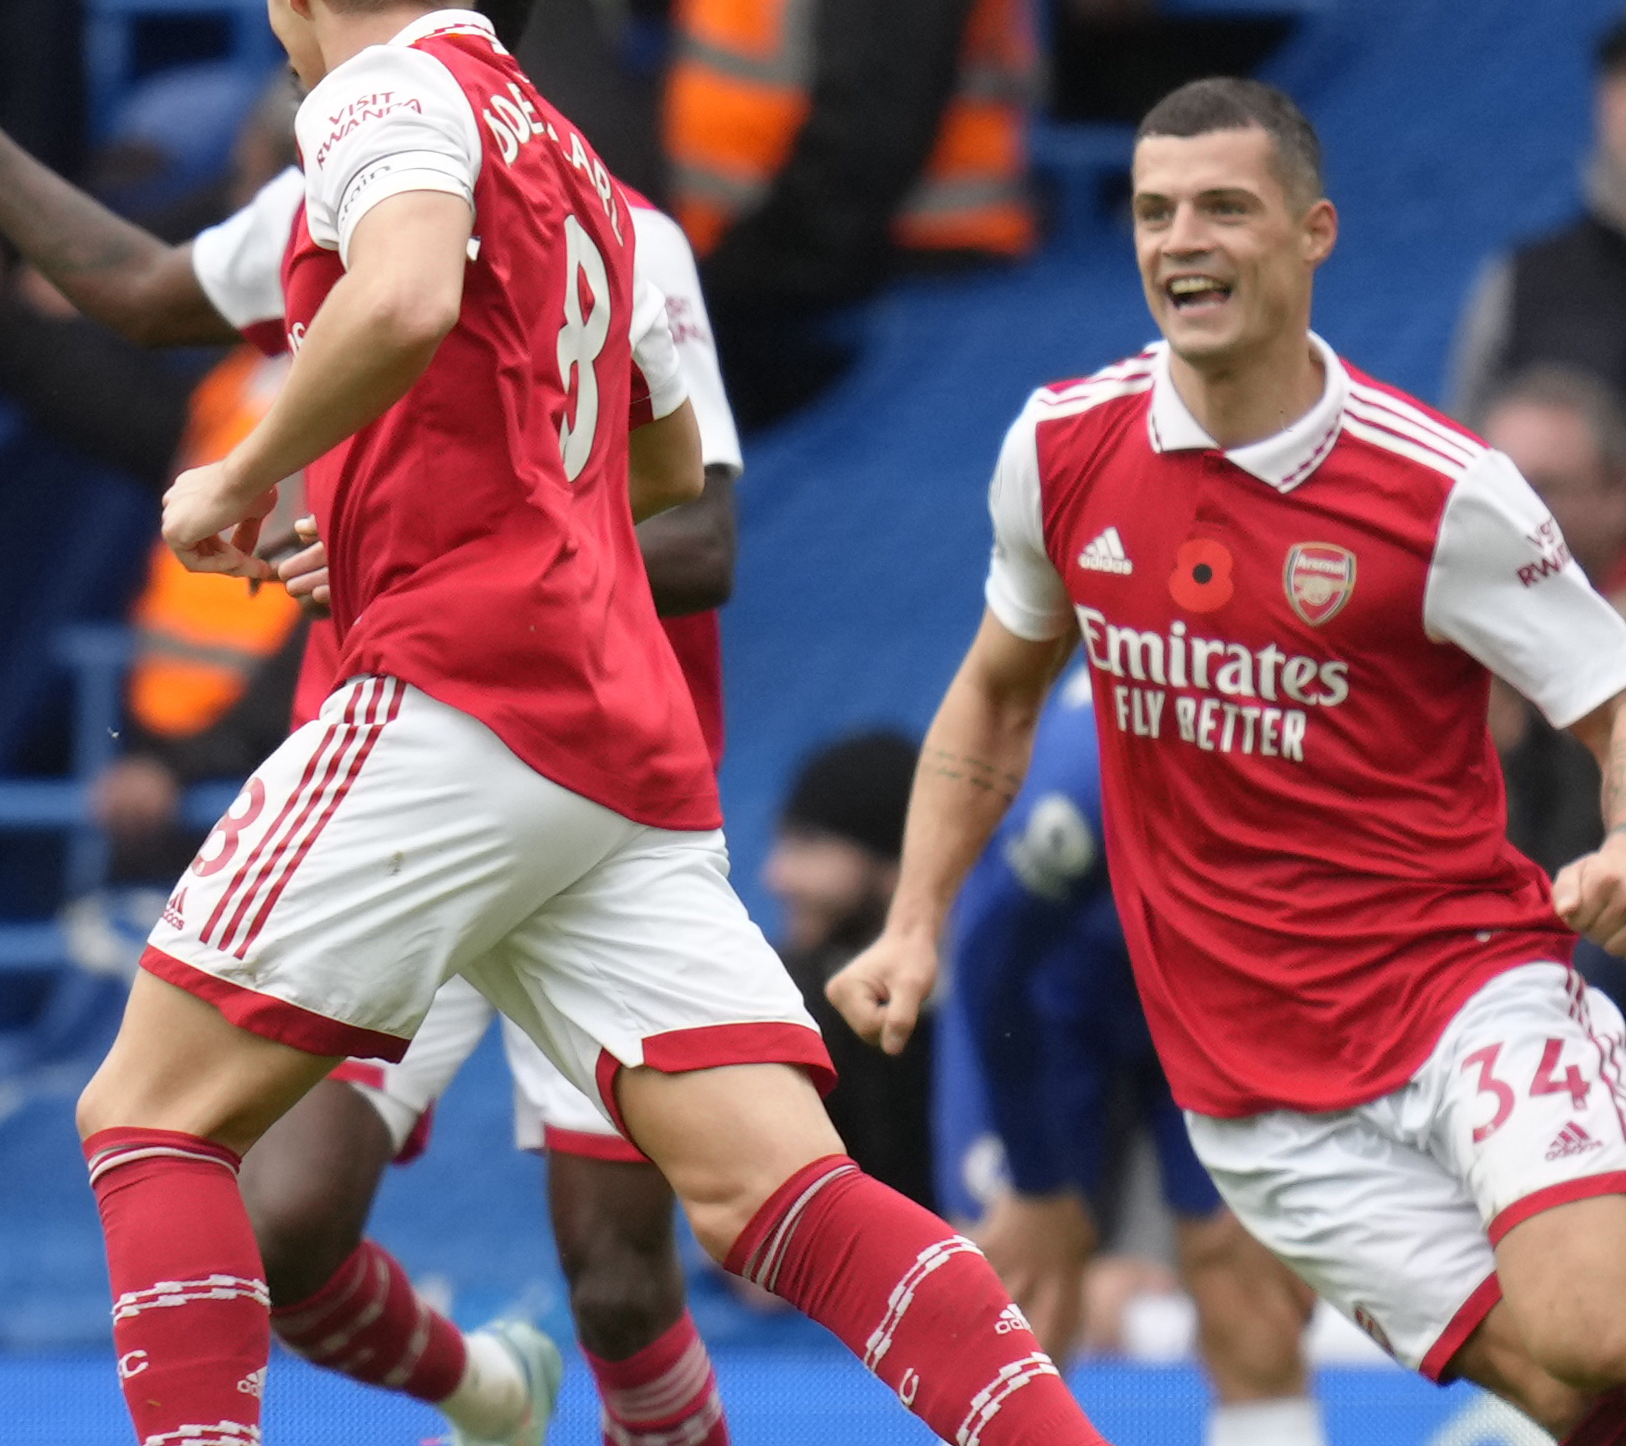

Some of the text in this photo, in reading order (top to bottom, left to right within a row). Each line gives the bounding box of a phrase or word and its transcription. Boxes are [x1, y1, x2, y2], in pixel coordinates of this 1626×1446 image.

[328, 91, 396, 125] VISIT
[556, 213, 612, 483] 8
[1074, 602, 1350, 708] Emirates
[1114, 684, 1308, 763] FLY BETTER
[1460, 1037, 1591, 1145] 34
